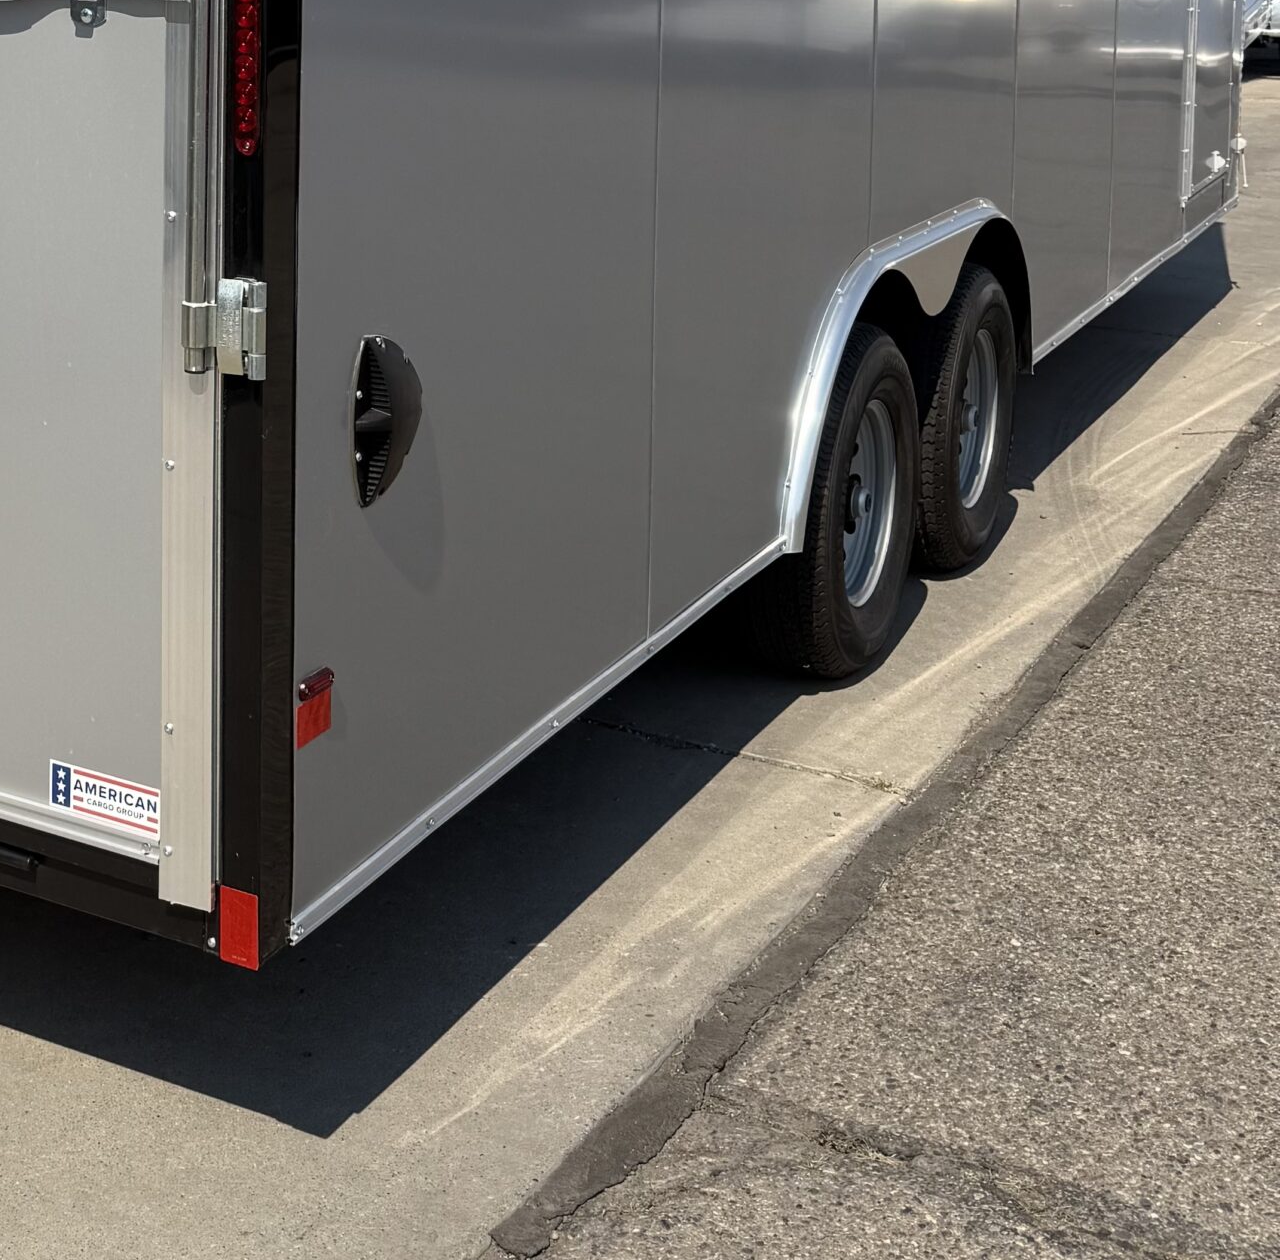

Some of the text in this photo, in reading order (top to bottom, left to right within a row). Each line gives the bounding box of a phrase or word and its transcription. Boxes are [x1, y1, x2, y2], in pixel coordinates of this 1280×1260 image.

[73, 779, 157, 814] AMERICAN
[86, 798, 145, 819] CARGO GROUP
